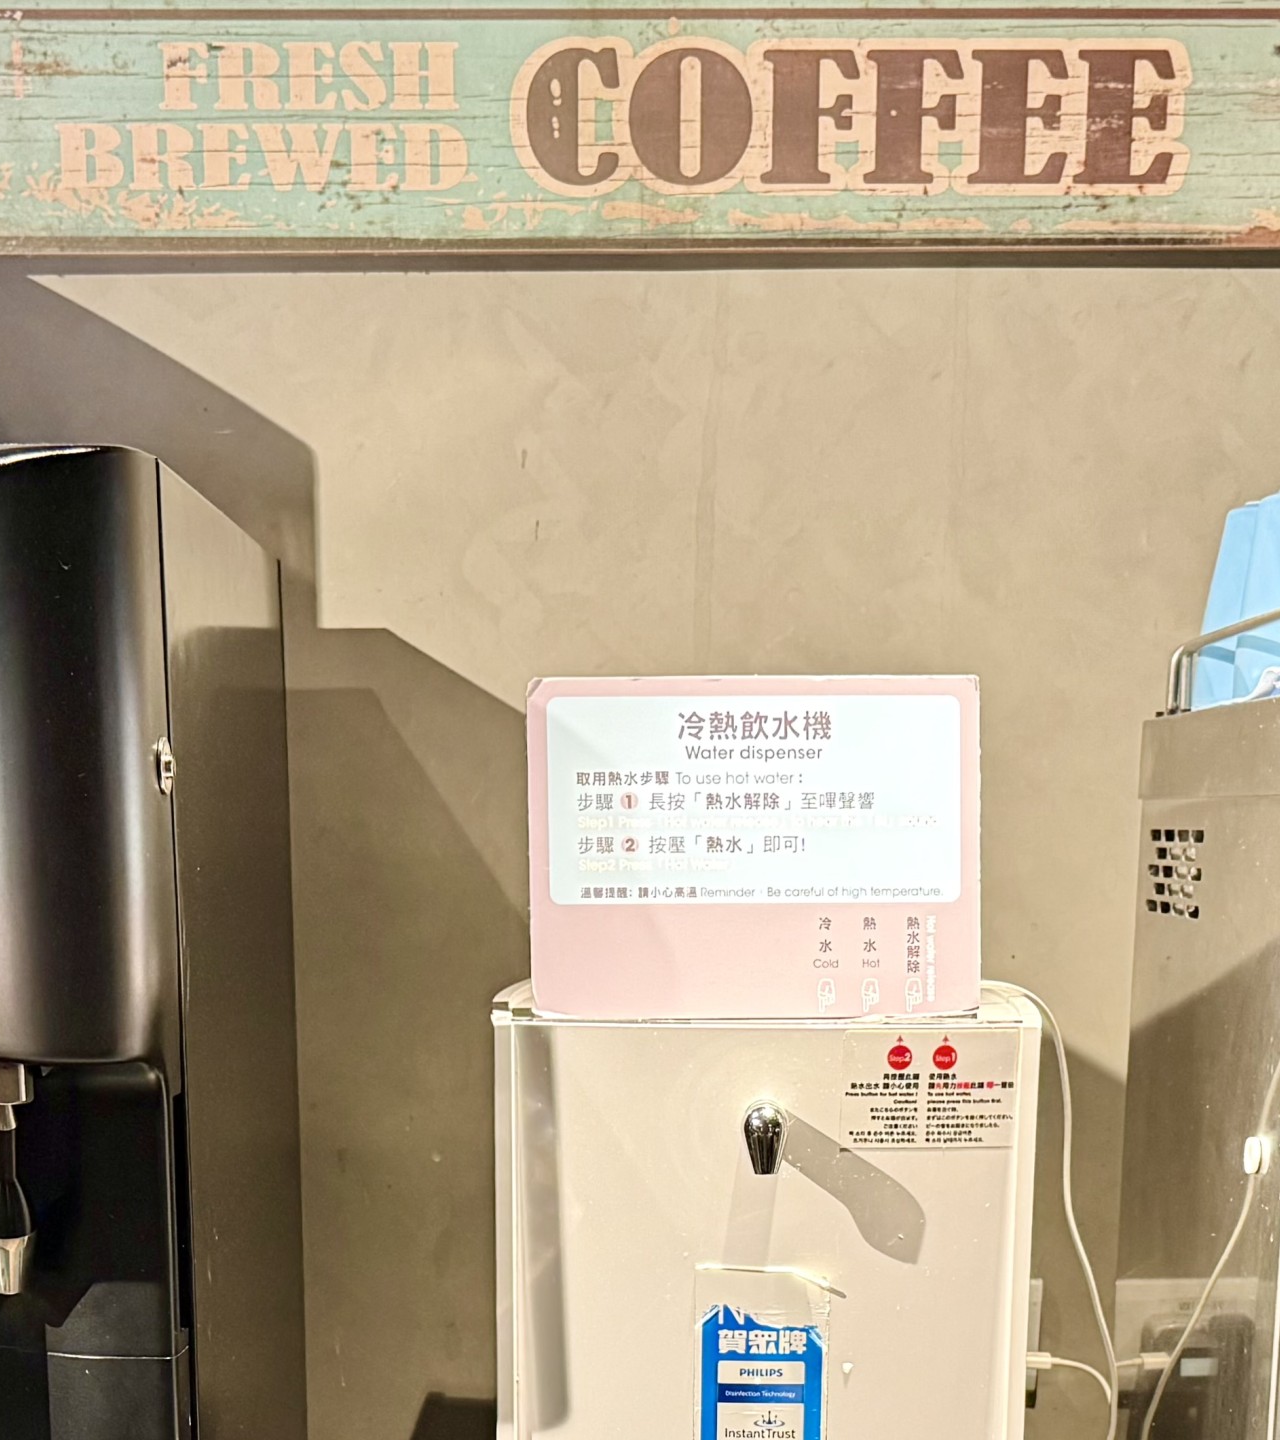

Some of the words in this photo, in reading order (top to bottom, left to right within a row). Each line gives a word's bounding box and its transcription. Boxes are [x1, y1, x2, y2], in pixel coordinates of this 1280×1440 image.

[158, 41, 460, 111] FRESH
[518, 38, 1188, 192] COFFEE
[53, 123, 468, 192] BREWED
[678, 710, 832, 741] 冷熱飲水機
[685, 745, 735, 760] Water
[739, 745, 823, 762] dispenser
[576, 770, 670, 787] 取用熱水步驟
[676, 771, 692, 785] To
[695, 773, 721, 785] use
[725, 771, 750, 785] hot
[577, 792, 614, 811] 步驟
[578, 836, 615, 854] 步驟
[767, 886, 782, 897] Be
[785, 886, 825, 897] careful
[827, 886, 839, 897] of
[842, 886, 868, 900] high
[870, 886, 944, 900] temperature.
[818, 916, 833, 953] 冷水
[863, 916, 877, 953] 熱水
[906, 916, 920, 974] 熱水解除
[813, 958, 839, 968] Cold
[862, 958, 880, 968] Hot
[739, 1368, 784, 1378] PHILIPS
[725, 1389, 760, 1398] Disinfection
[762, 1389, 796, 1399] Technology
[725, 1428, 796, 1440] InstantTrust
